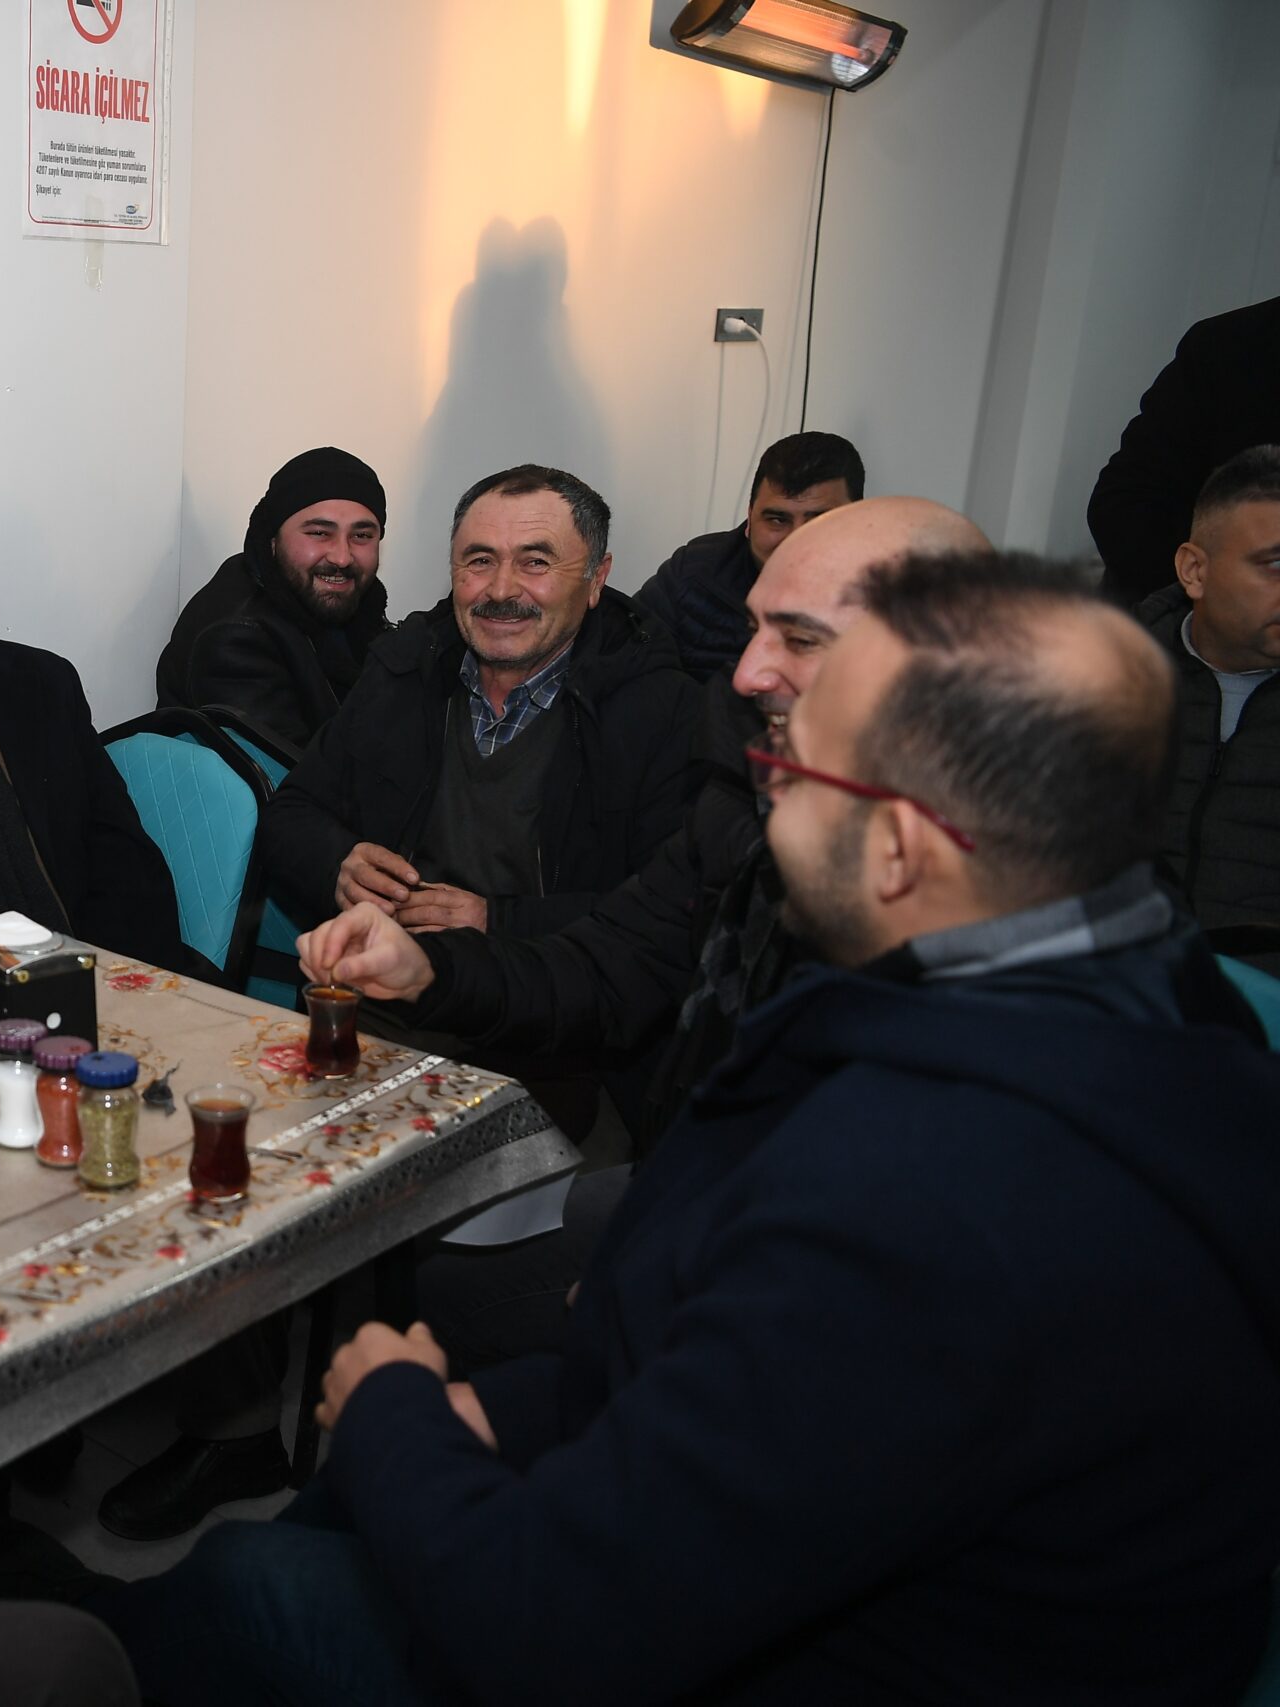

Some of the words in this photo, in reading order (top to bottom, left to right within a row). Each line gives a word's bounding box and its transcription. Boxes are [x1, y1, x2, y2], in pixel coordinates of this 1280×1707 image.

[36, 59, 90, 115] SİGARA
[94, 67, 150, 124] İÇİLMEZ
[51, 140, 65, 151] Burada
[64, 157, 69, 165] ve
[36, 165, 48, 175] 4207
[61, 168, 73, 177] Kanun
[104, 173, 113, 182] para
[36, 184, 51, 196] Şikayet
